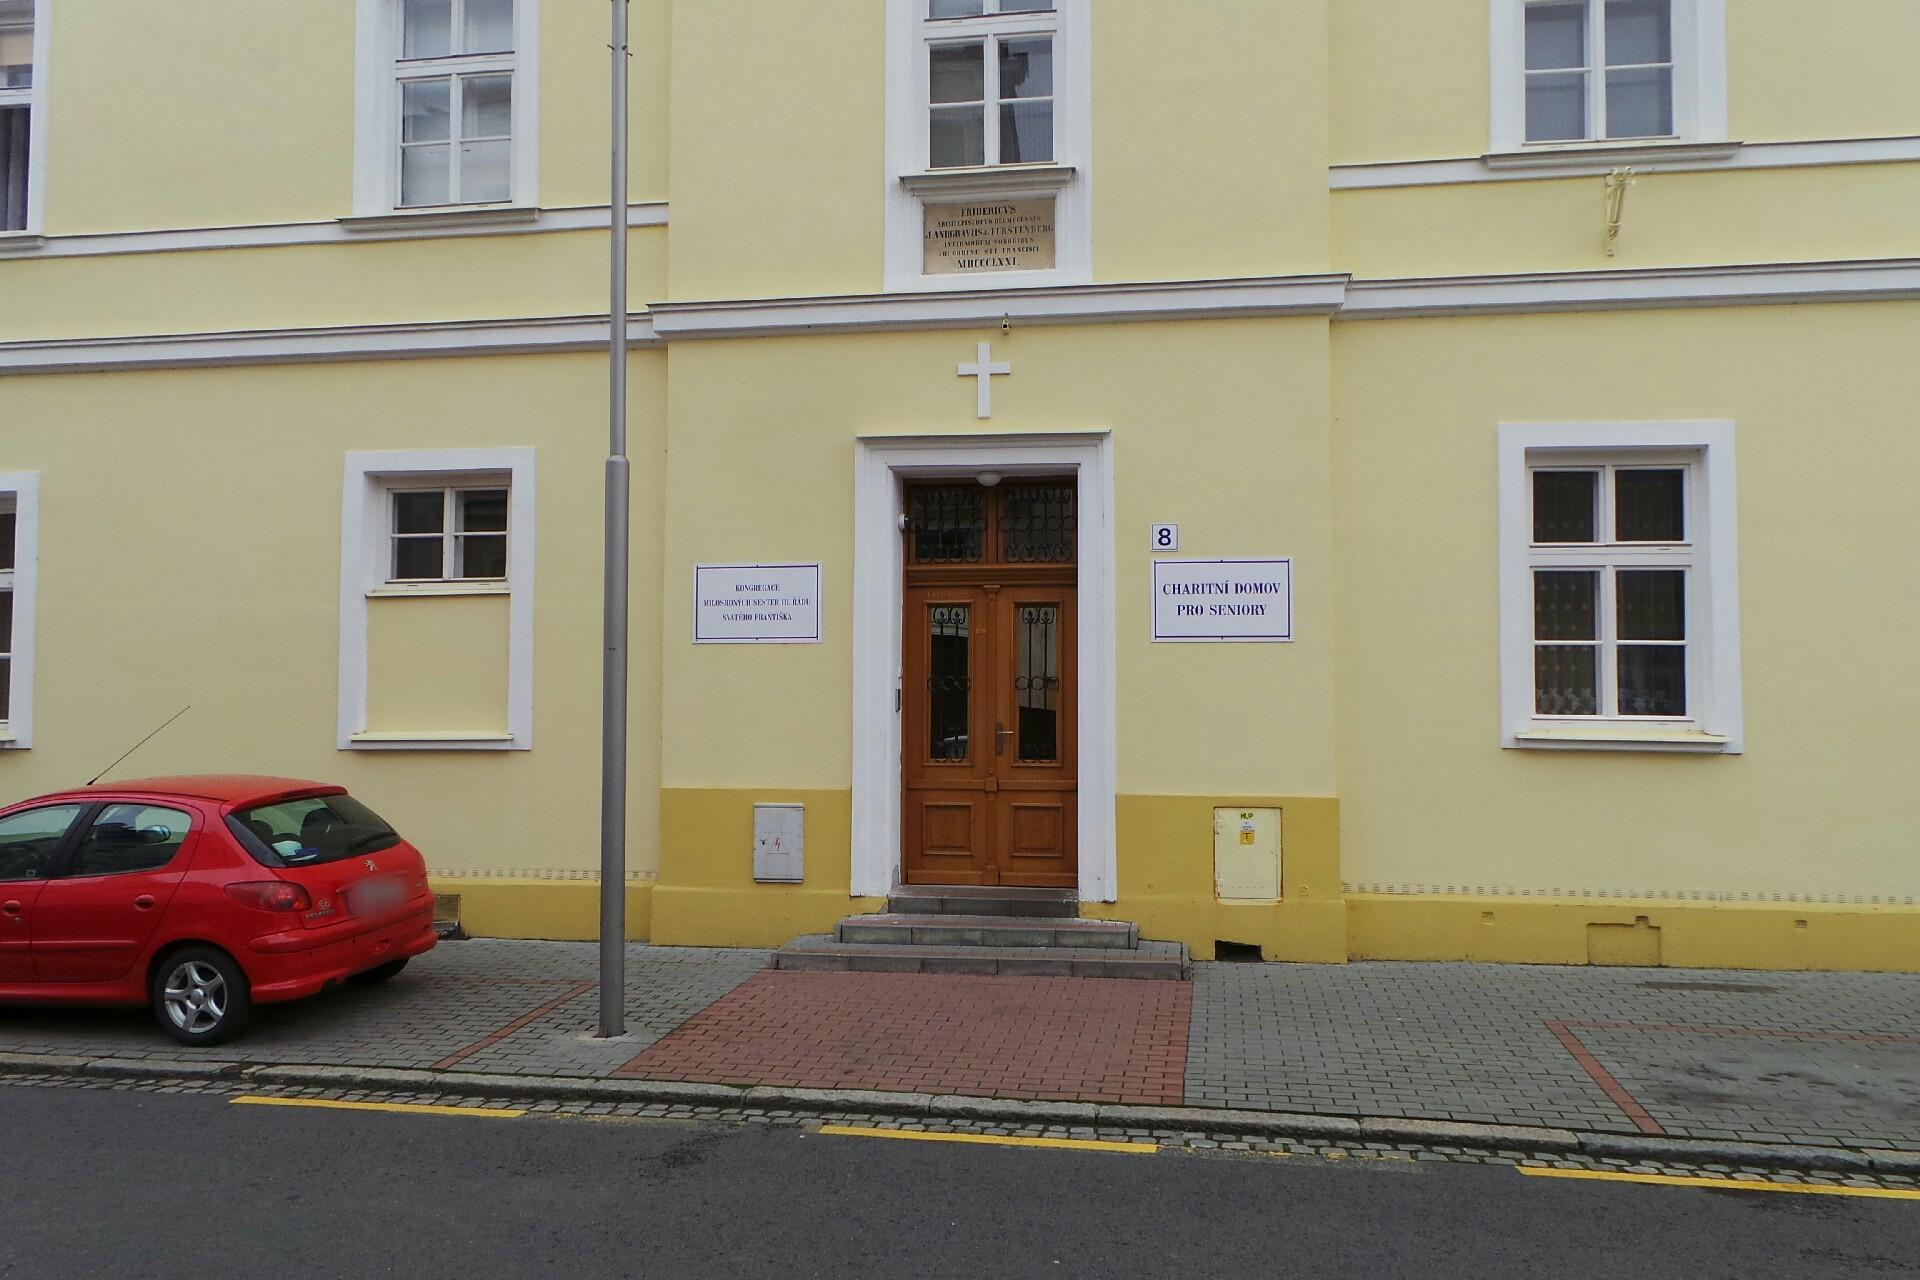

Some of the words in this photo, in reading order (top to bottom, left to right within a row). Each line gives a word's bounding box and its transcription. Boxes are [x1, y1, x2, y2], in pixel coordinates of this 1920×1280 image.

[1157, 527, 1172, 546] 8
[735, 583, 781, 592] KONGREGACE
[1162, 580, 1229, 595] CHARITNÍ
[1234, 582, 1281, 594] DOMOV
[703, 597, 751, 607] MILOSRDNÝCH
[752, 598, 780, 606] SESTER
[1177, 604, 1204, 616] PRO
[1209, 604, 1267, 616] SENIORY
[722, 612, 753, 621] SVATÉHO
[754, 611, 793, 621] FRANTIŠKA
